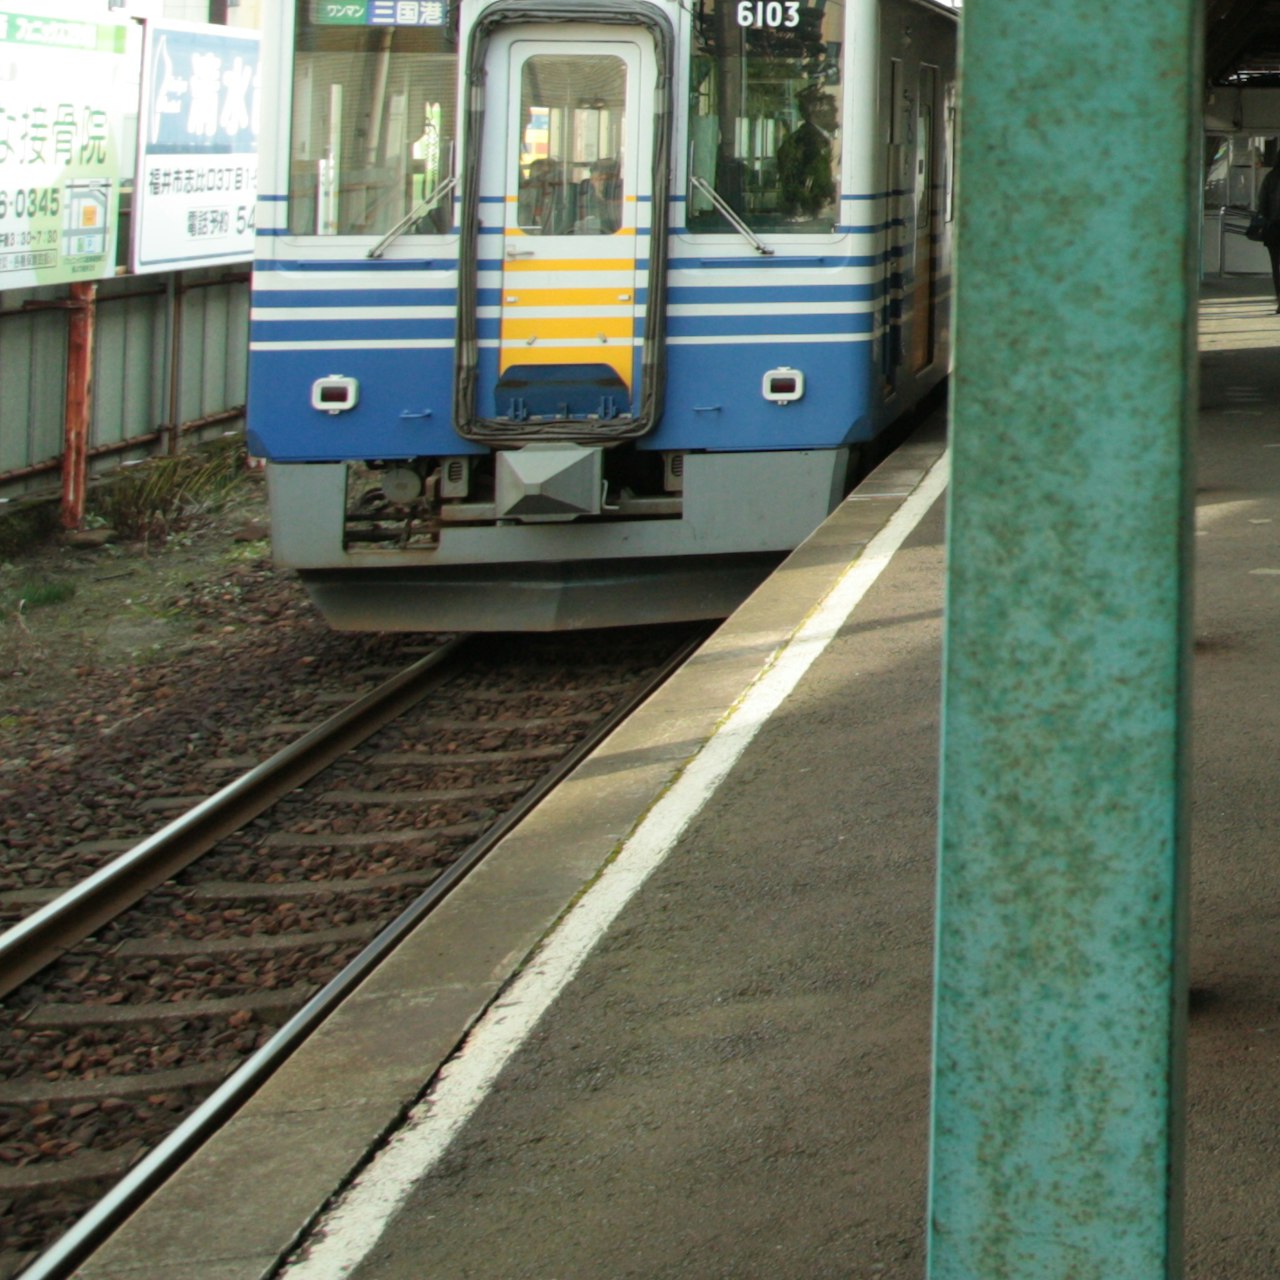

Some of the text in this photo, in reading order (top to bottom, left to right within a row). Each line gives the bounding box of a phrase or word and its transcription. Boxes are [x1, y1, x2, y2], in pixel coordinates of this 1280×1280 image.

[327, 0, 442, 26] ワンマン 三国港
[737, 1, 800, 27] 6103
[187, 51, 260, 137] 清水
[187, 210, 229, 236] 電話予約
